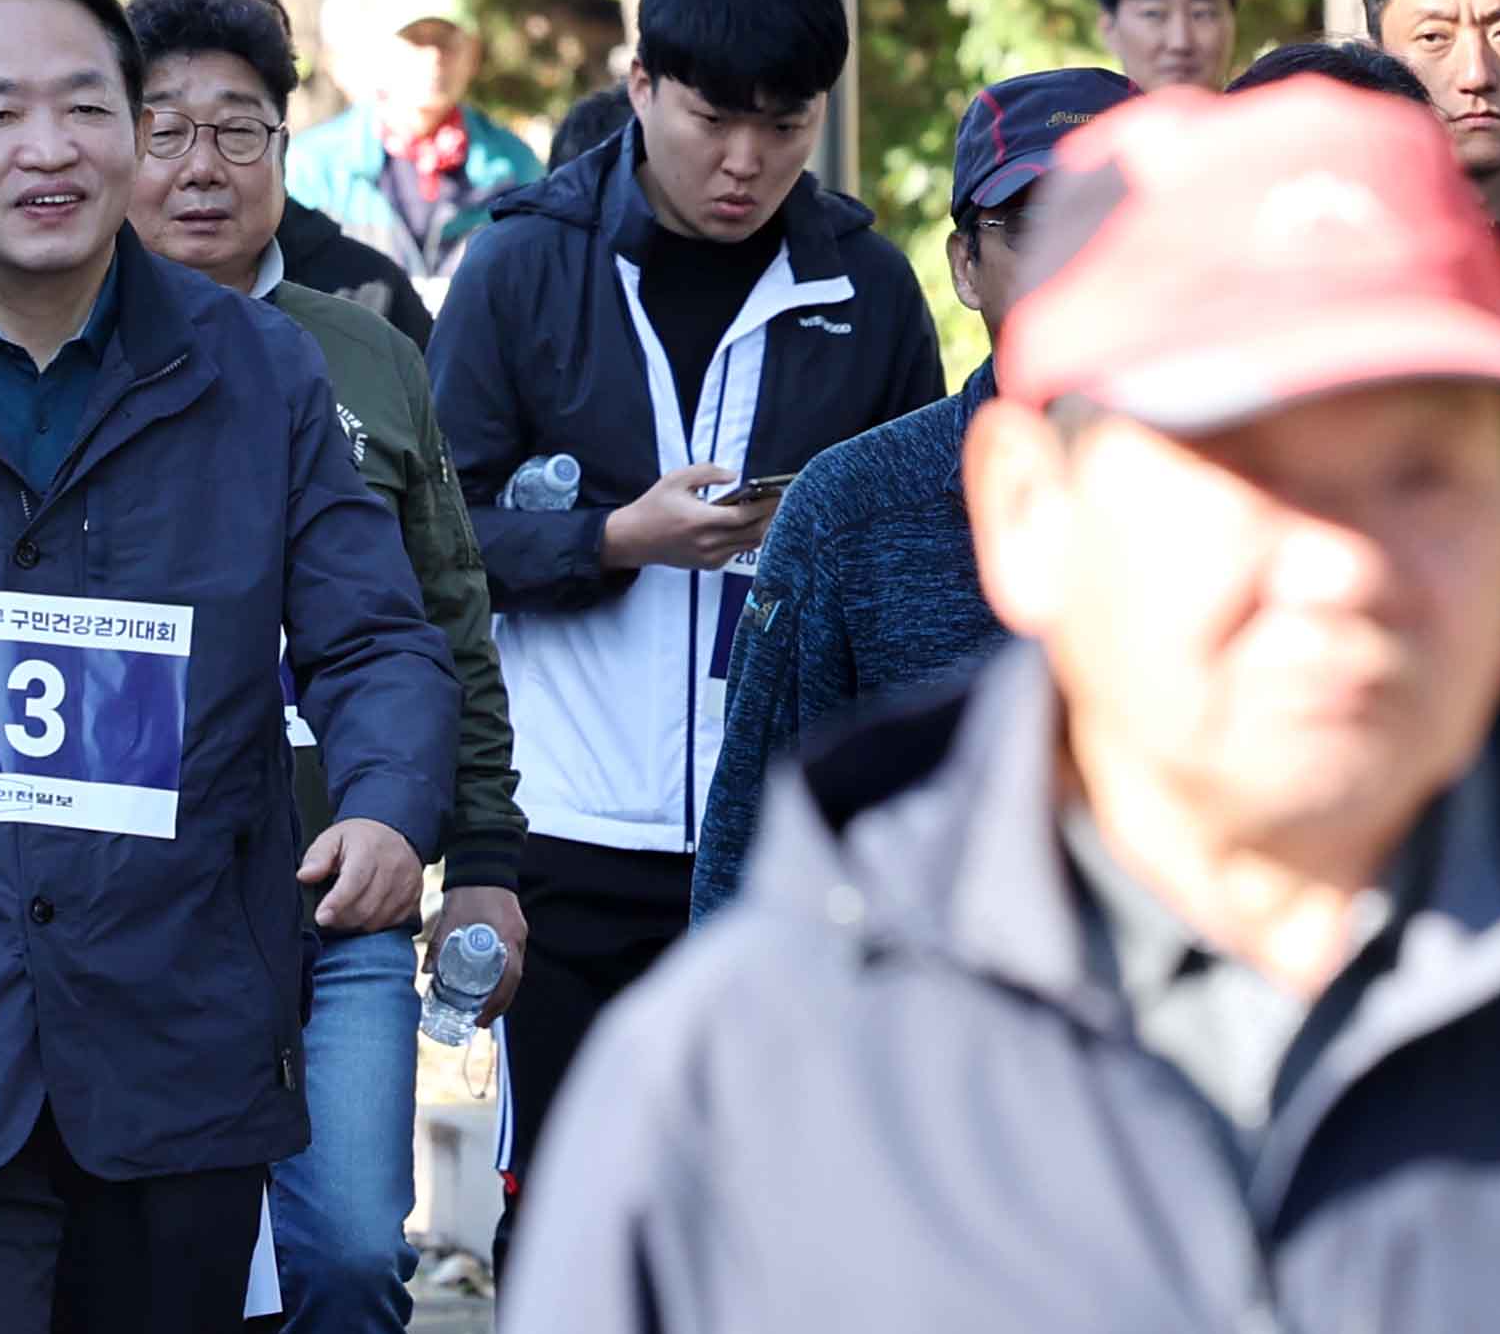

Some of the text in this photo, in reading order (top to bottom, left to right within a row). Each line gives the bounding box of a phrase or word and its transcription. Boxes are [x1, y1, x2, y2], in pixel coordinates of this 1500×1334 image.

[735, 550, 757, 565] 20
[10, 608, 176, 643] 구민건강걷기대회
[4, 659, 66, 758] 3
